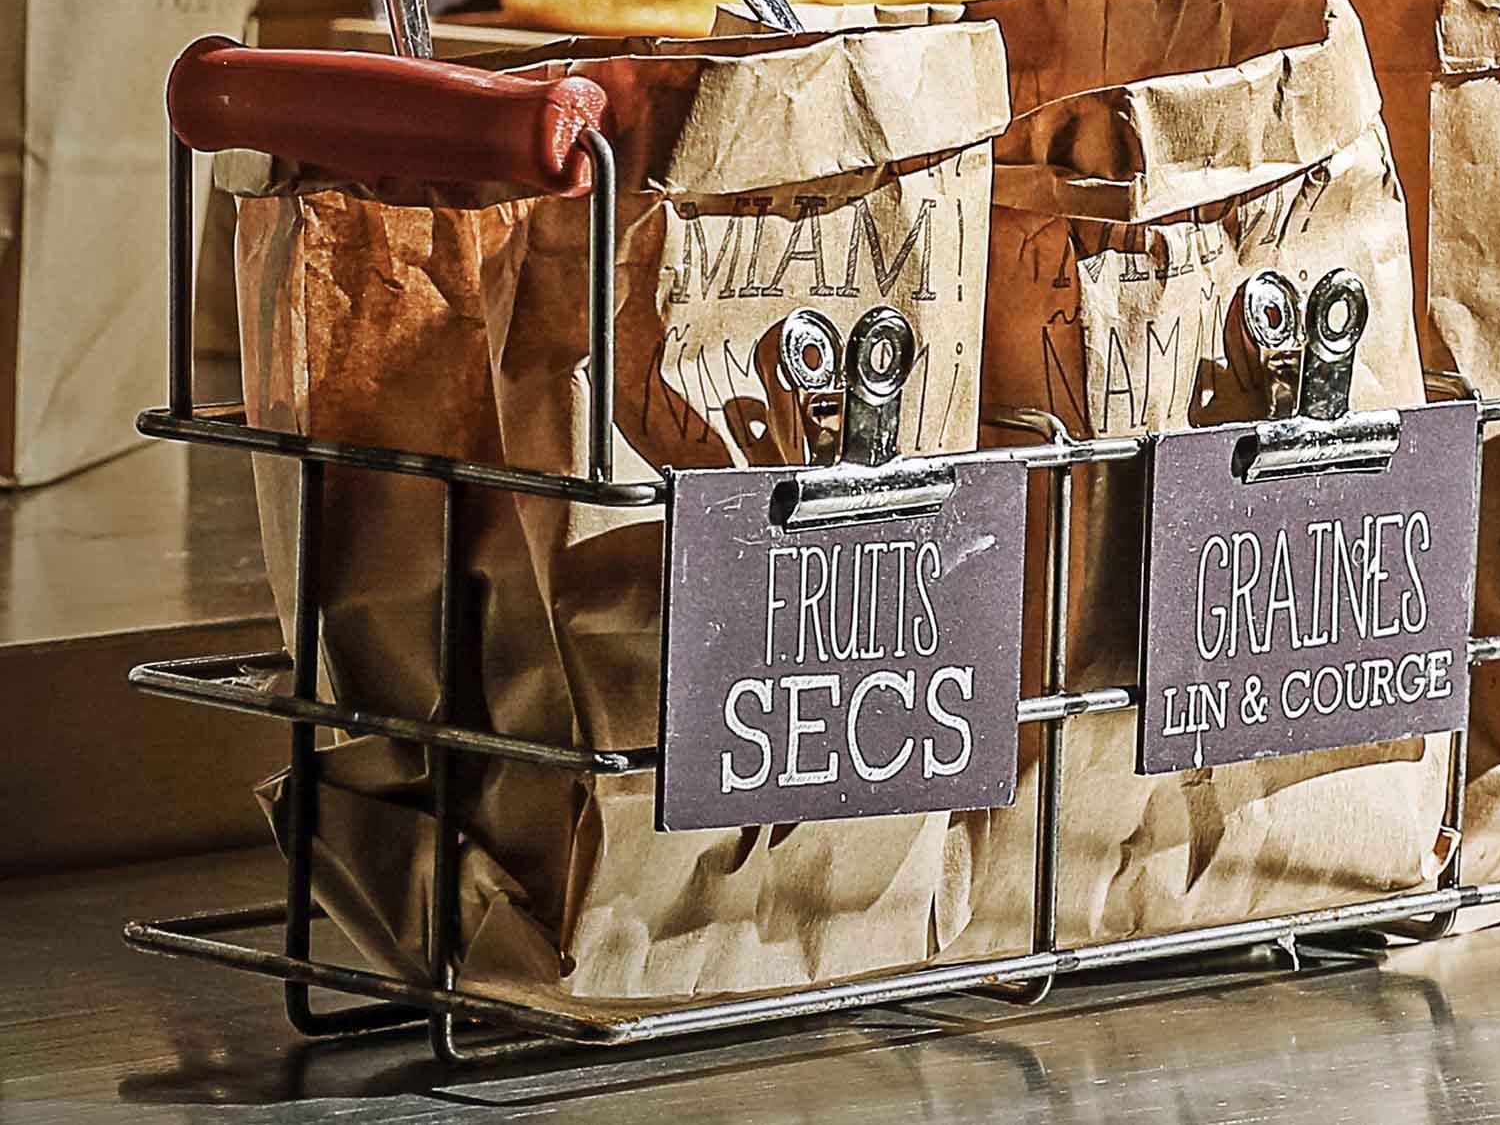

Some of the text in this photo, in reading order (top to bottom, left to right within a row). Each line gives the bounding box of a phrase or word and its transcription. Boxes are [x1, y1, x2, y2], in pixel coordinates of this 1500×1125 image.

[765, 541, 943, 666] FRUITS
[1196, 510, 1431, 661] GRAINES
[720, 665, 974, 793] SECS
[1162, 649, 1454, 736] LIN & COURGE
